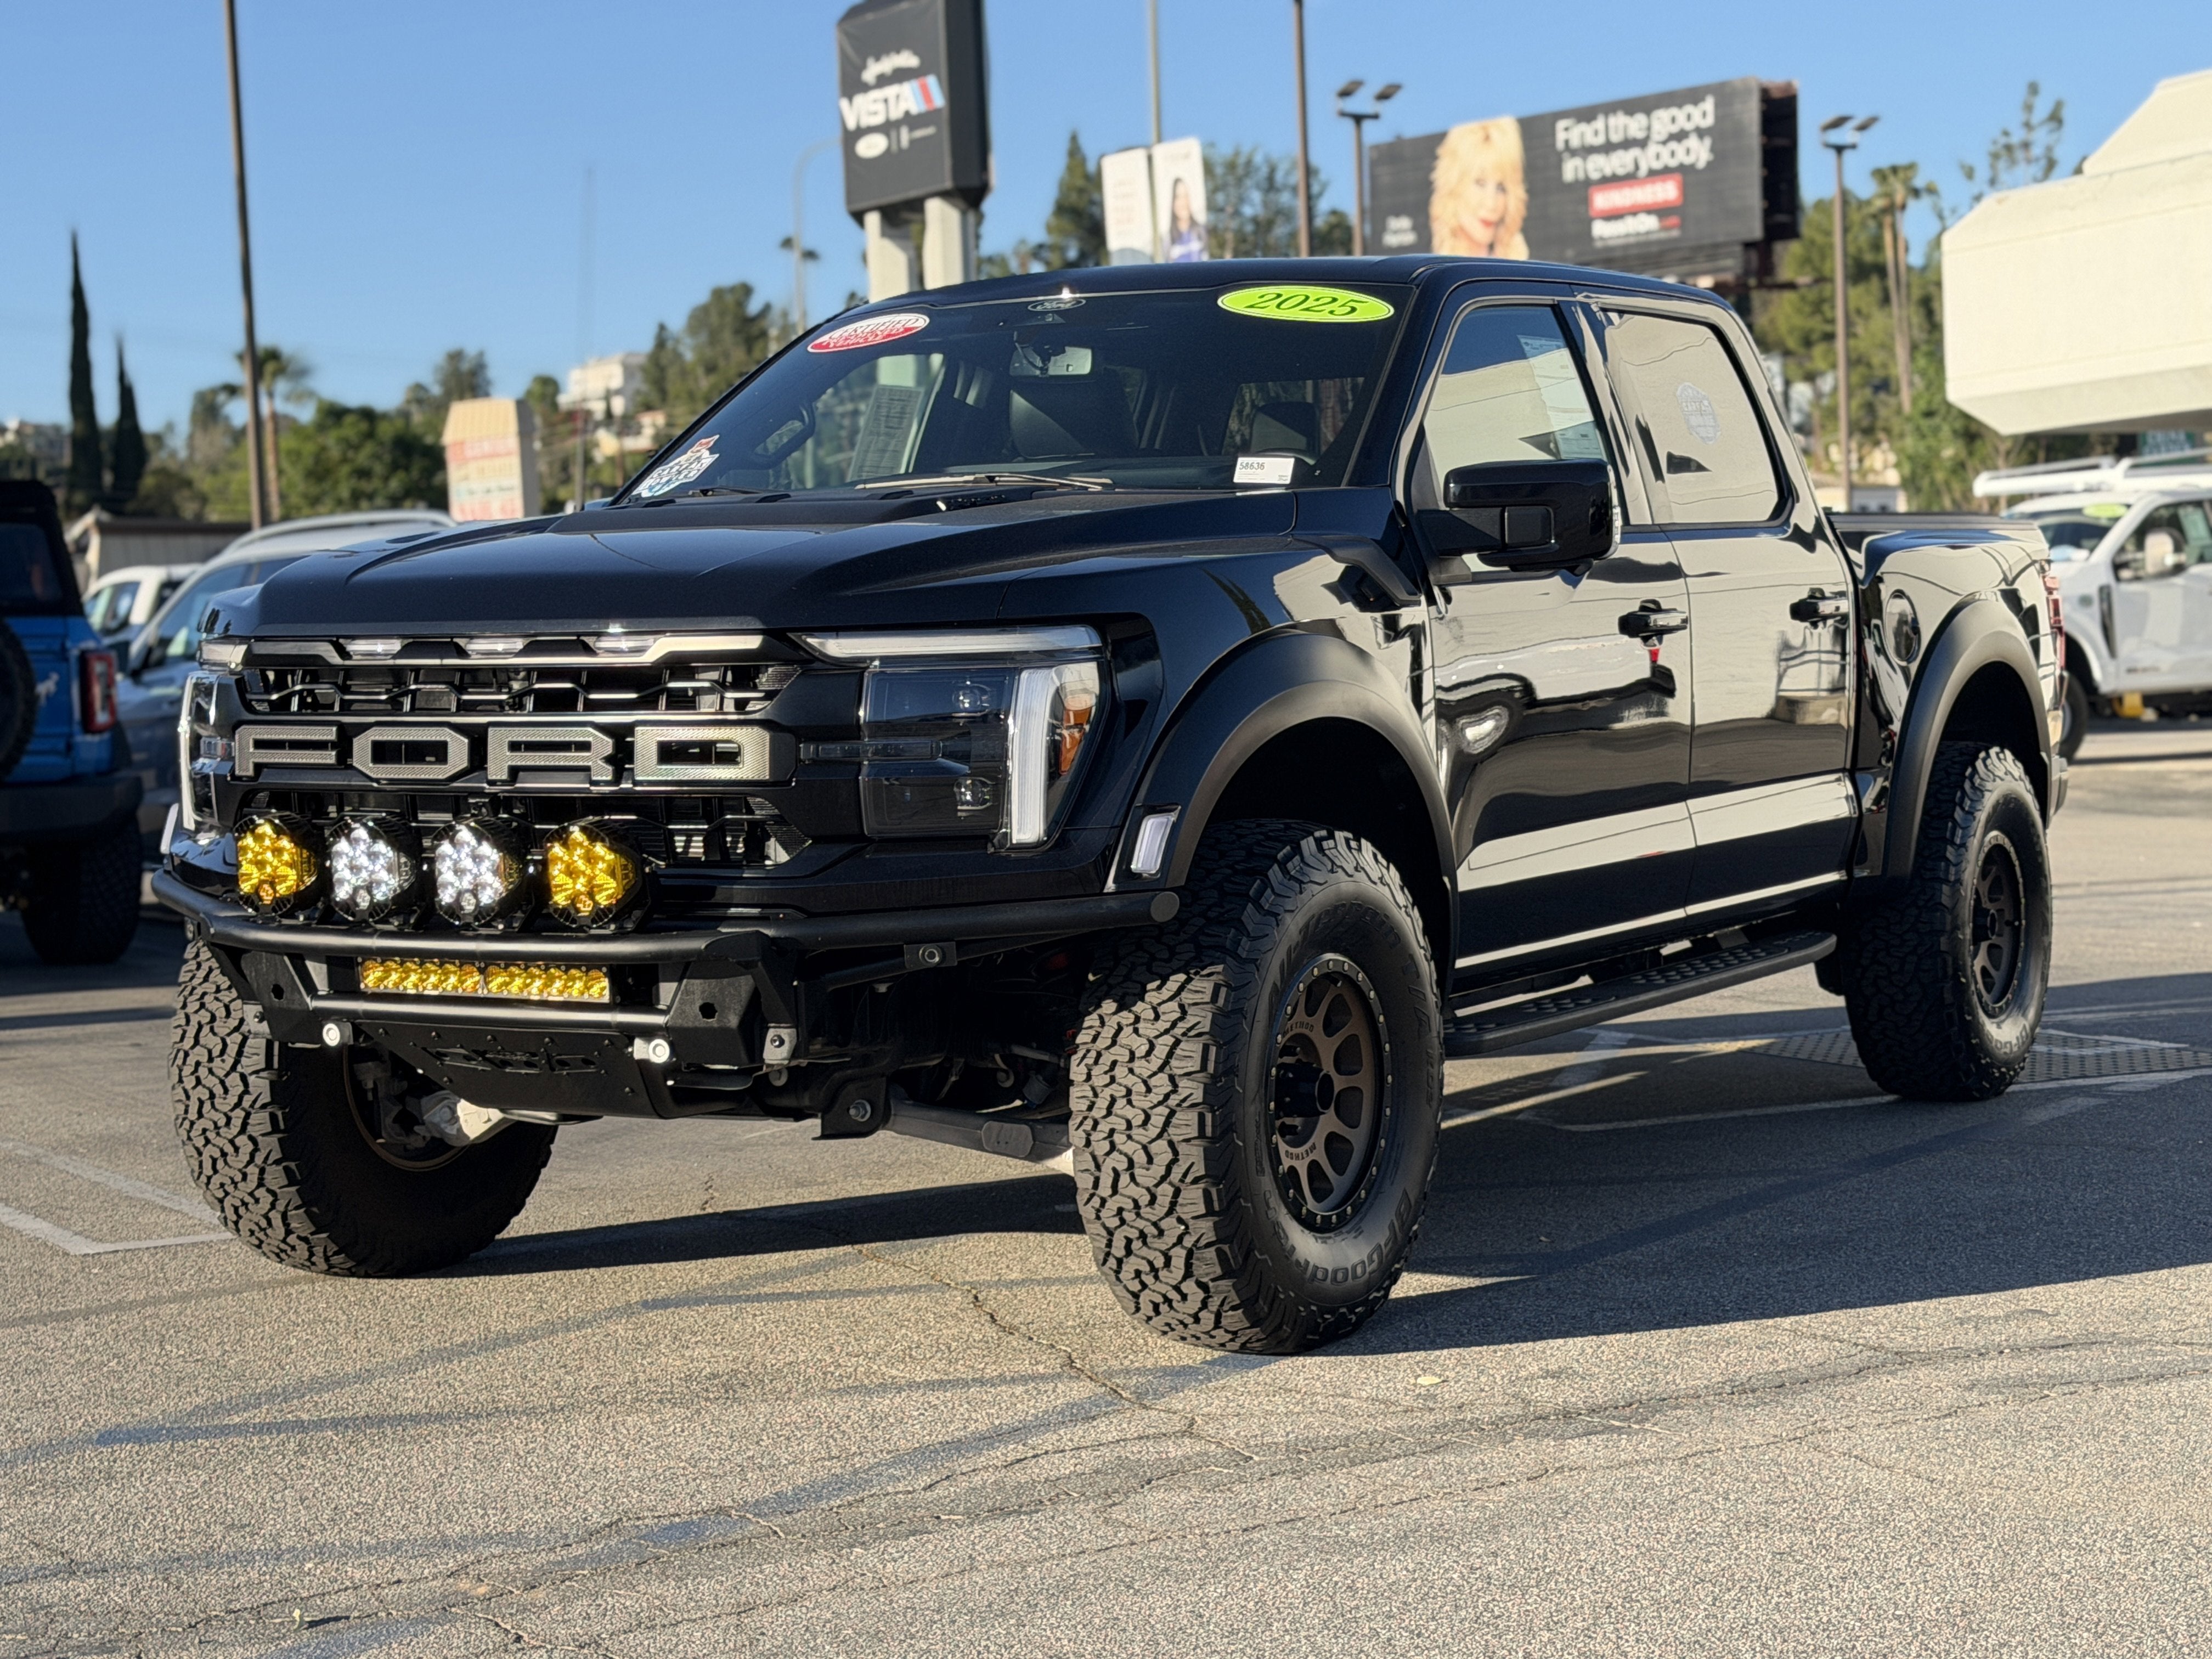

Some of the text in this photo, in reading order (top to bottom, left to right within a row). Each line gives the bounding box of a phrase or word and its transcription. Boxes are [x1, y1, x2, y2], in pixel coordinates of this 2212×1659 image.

[839, 82, 919, 131] VISTA
[1555, 94, 1715, 152] Find the good
[1562, 132, 1714, 184] in everybody.
[1244, 292, 1369, 317] 2025
[828, 318, 919, 340] CERTIFIED
[234, 725, 771, 781] FORD
[1283, 1020, 1314, 1039] METHOD
[1285, 1142, 1317, 1160] METHOD
